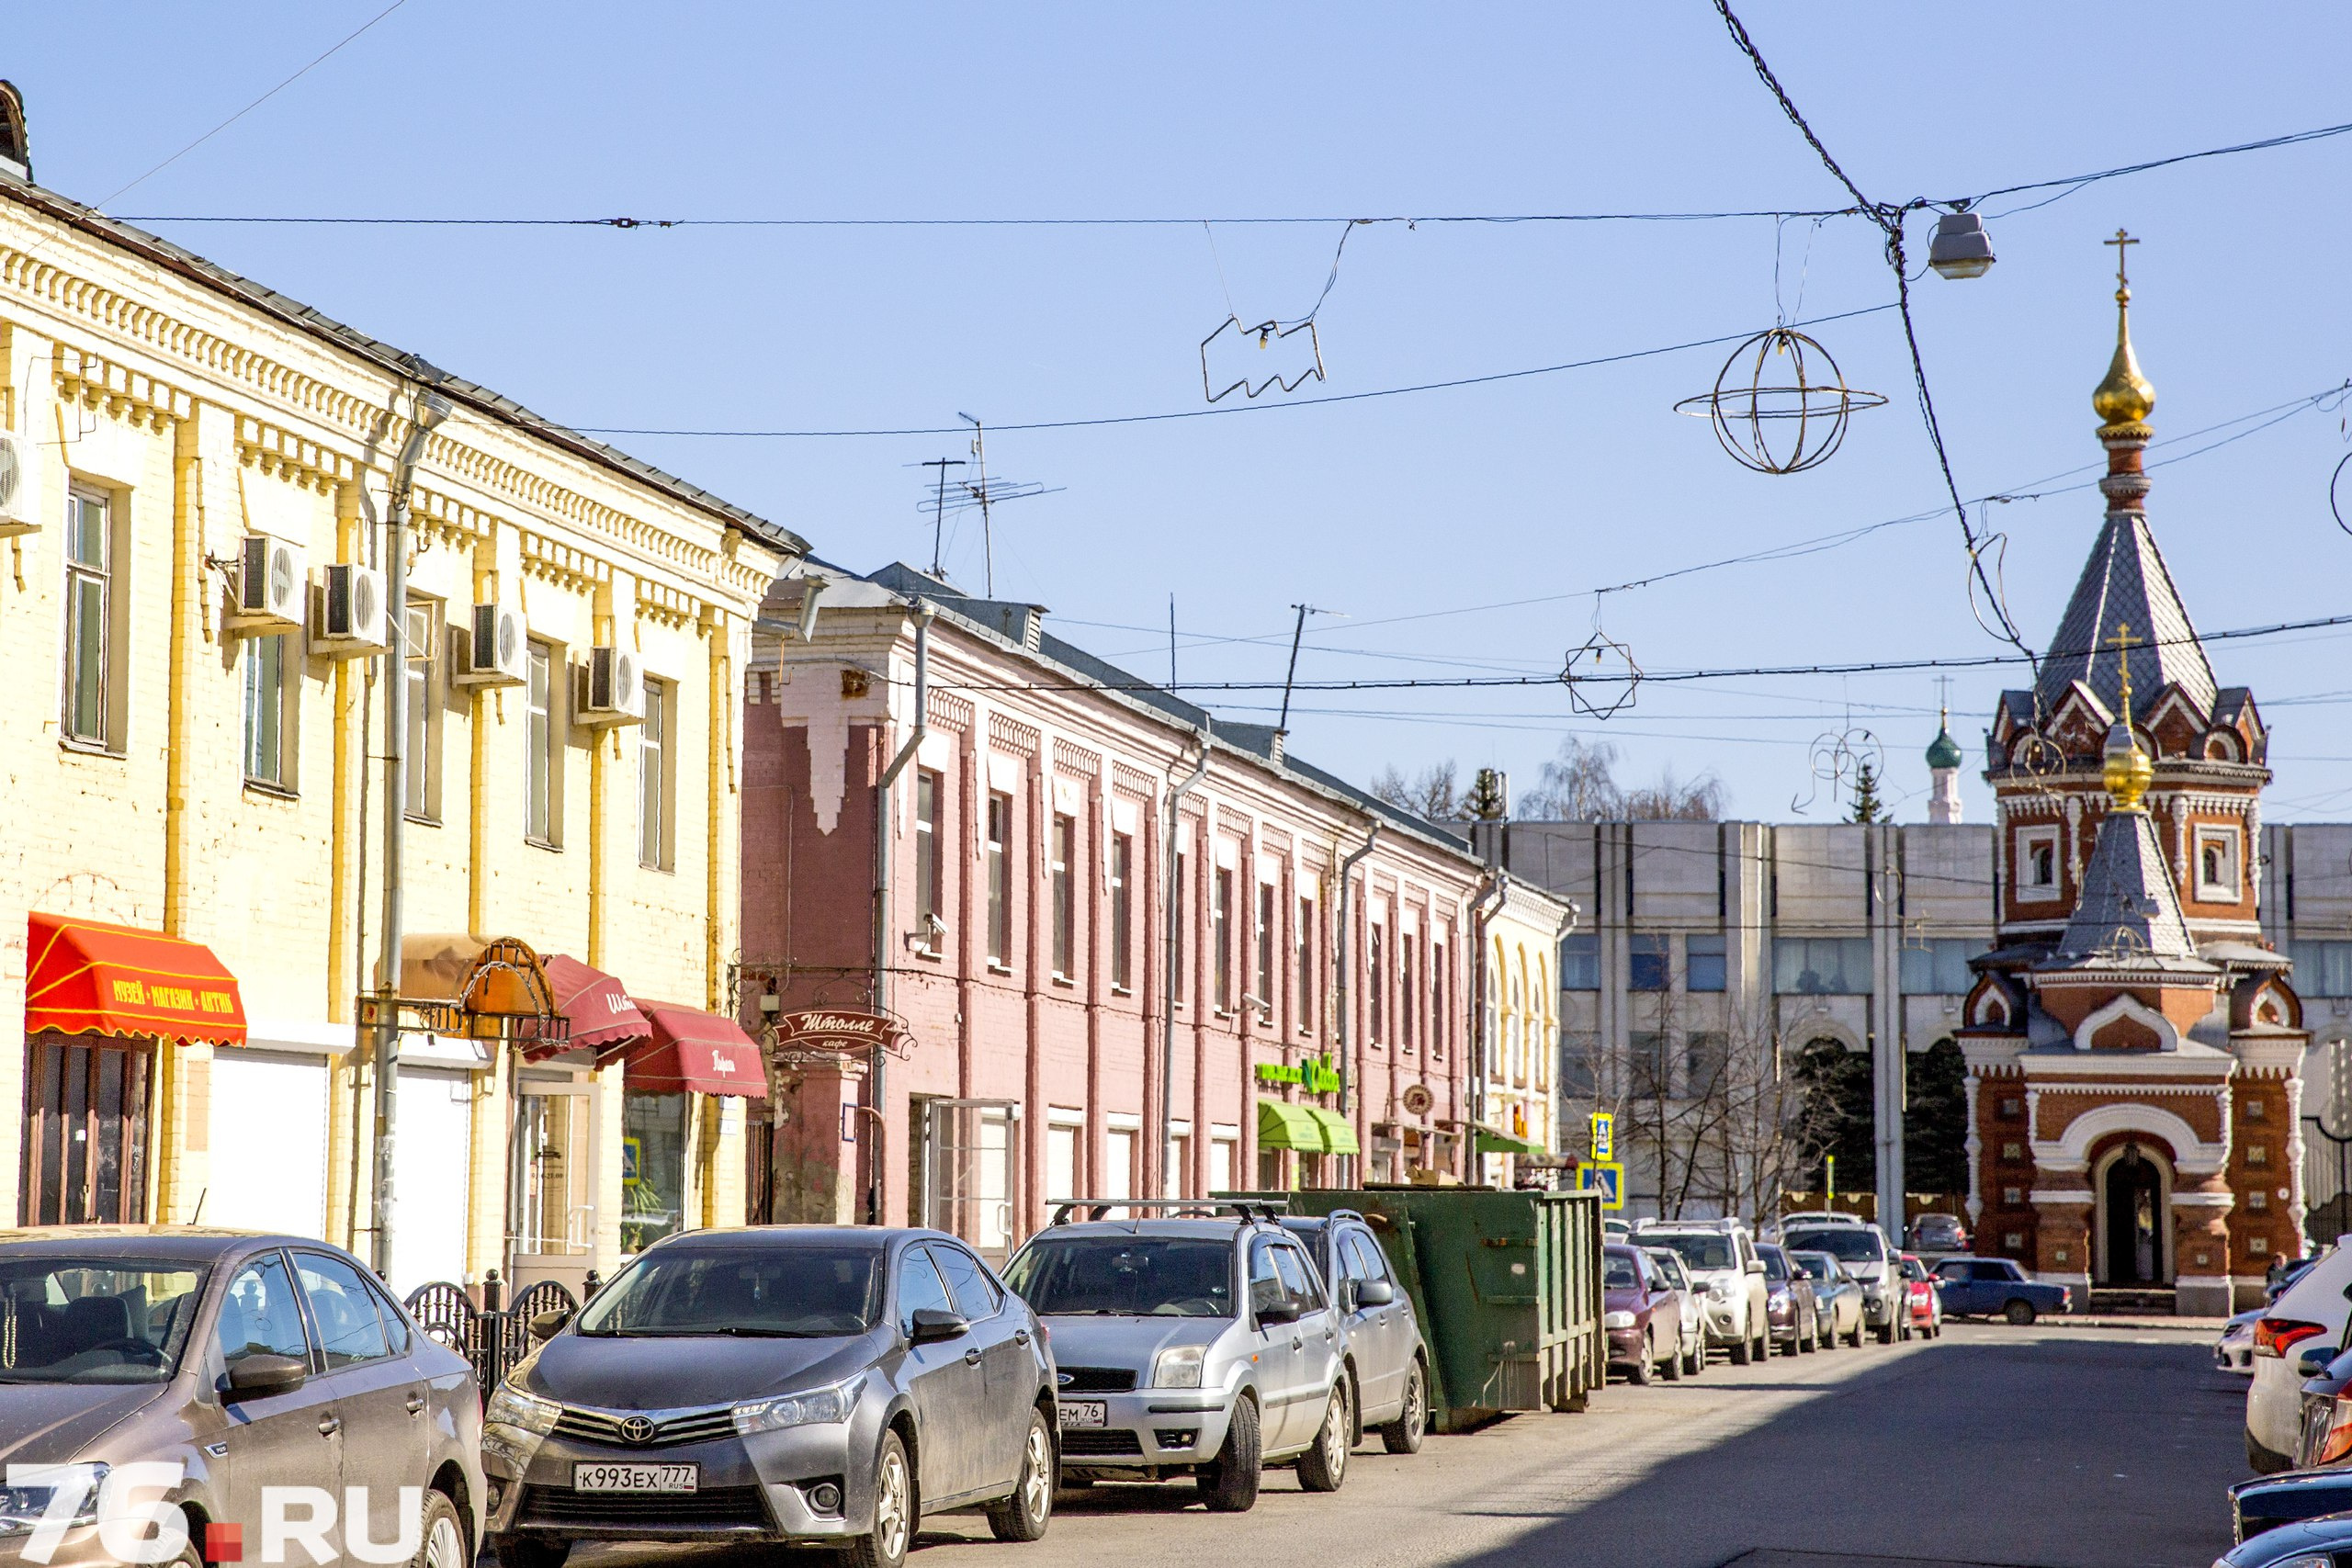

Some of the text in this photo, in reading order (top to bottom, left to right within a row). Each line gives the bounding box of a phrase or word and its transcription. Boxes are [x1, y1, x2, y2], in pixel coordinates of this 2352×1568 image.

[113, 979, 145, 1006] МУЗЕЙ
[150, 985, 195, 1010] МАГАЗИН
[800, 1013, 875, 1032] Штолле
[822, 1038, 848, 1050] кафе
[1084, 1404, 1099, 1417] 76
[582, 1466, 691, 1488] К993ЕХ 777
